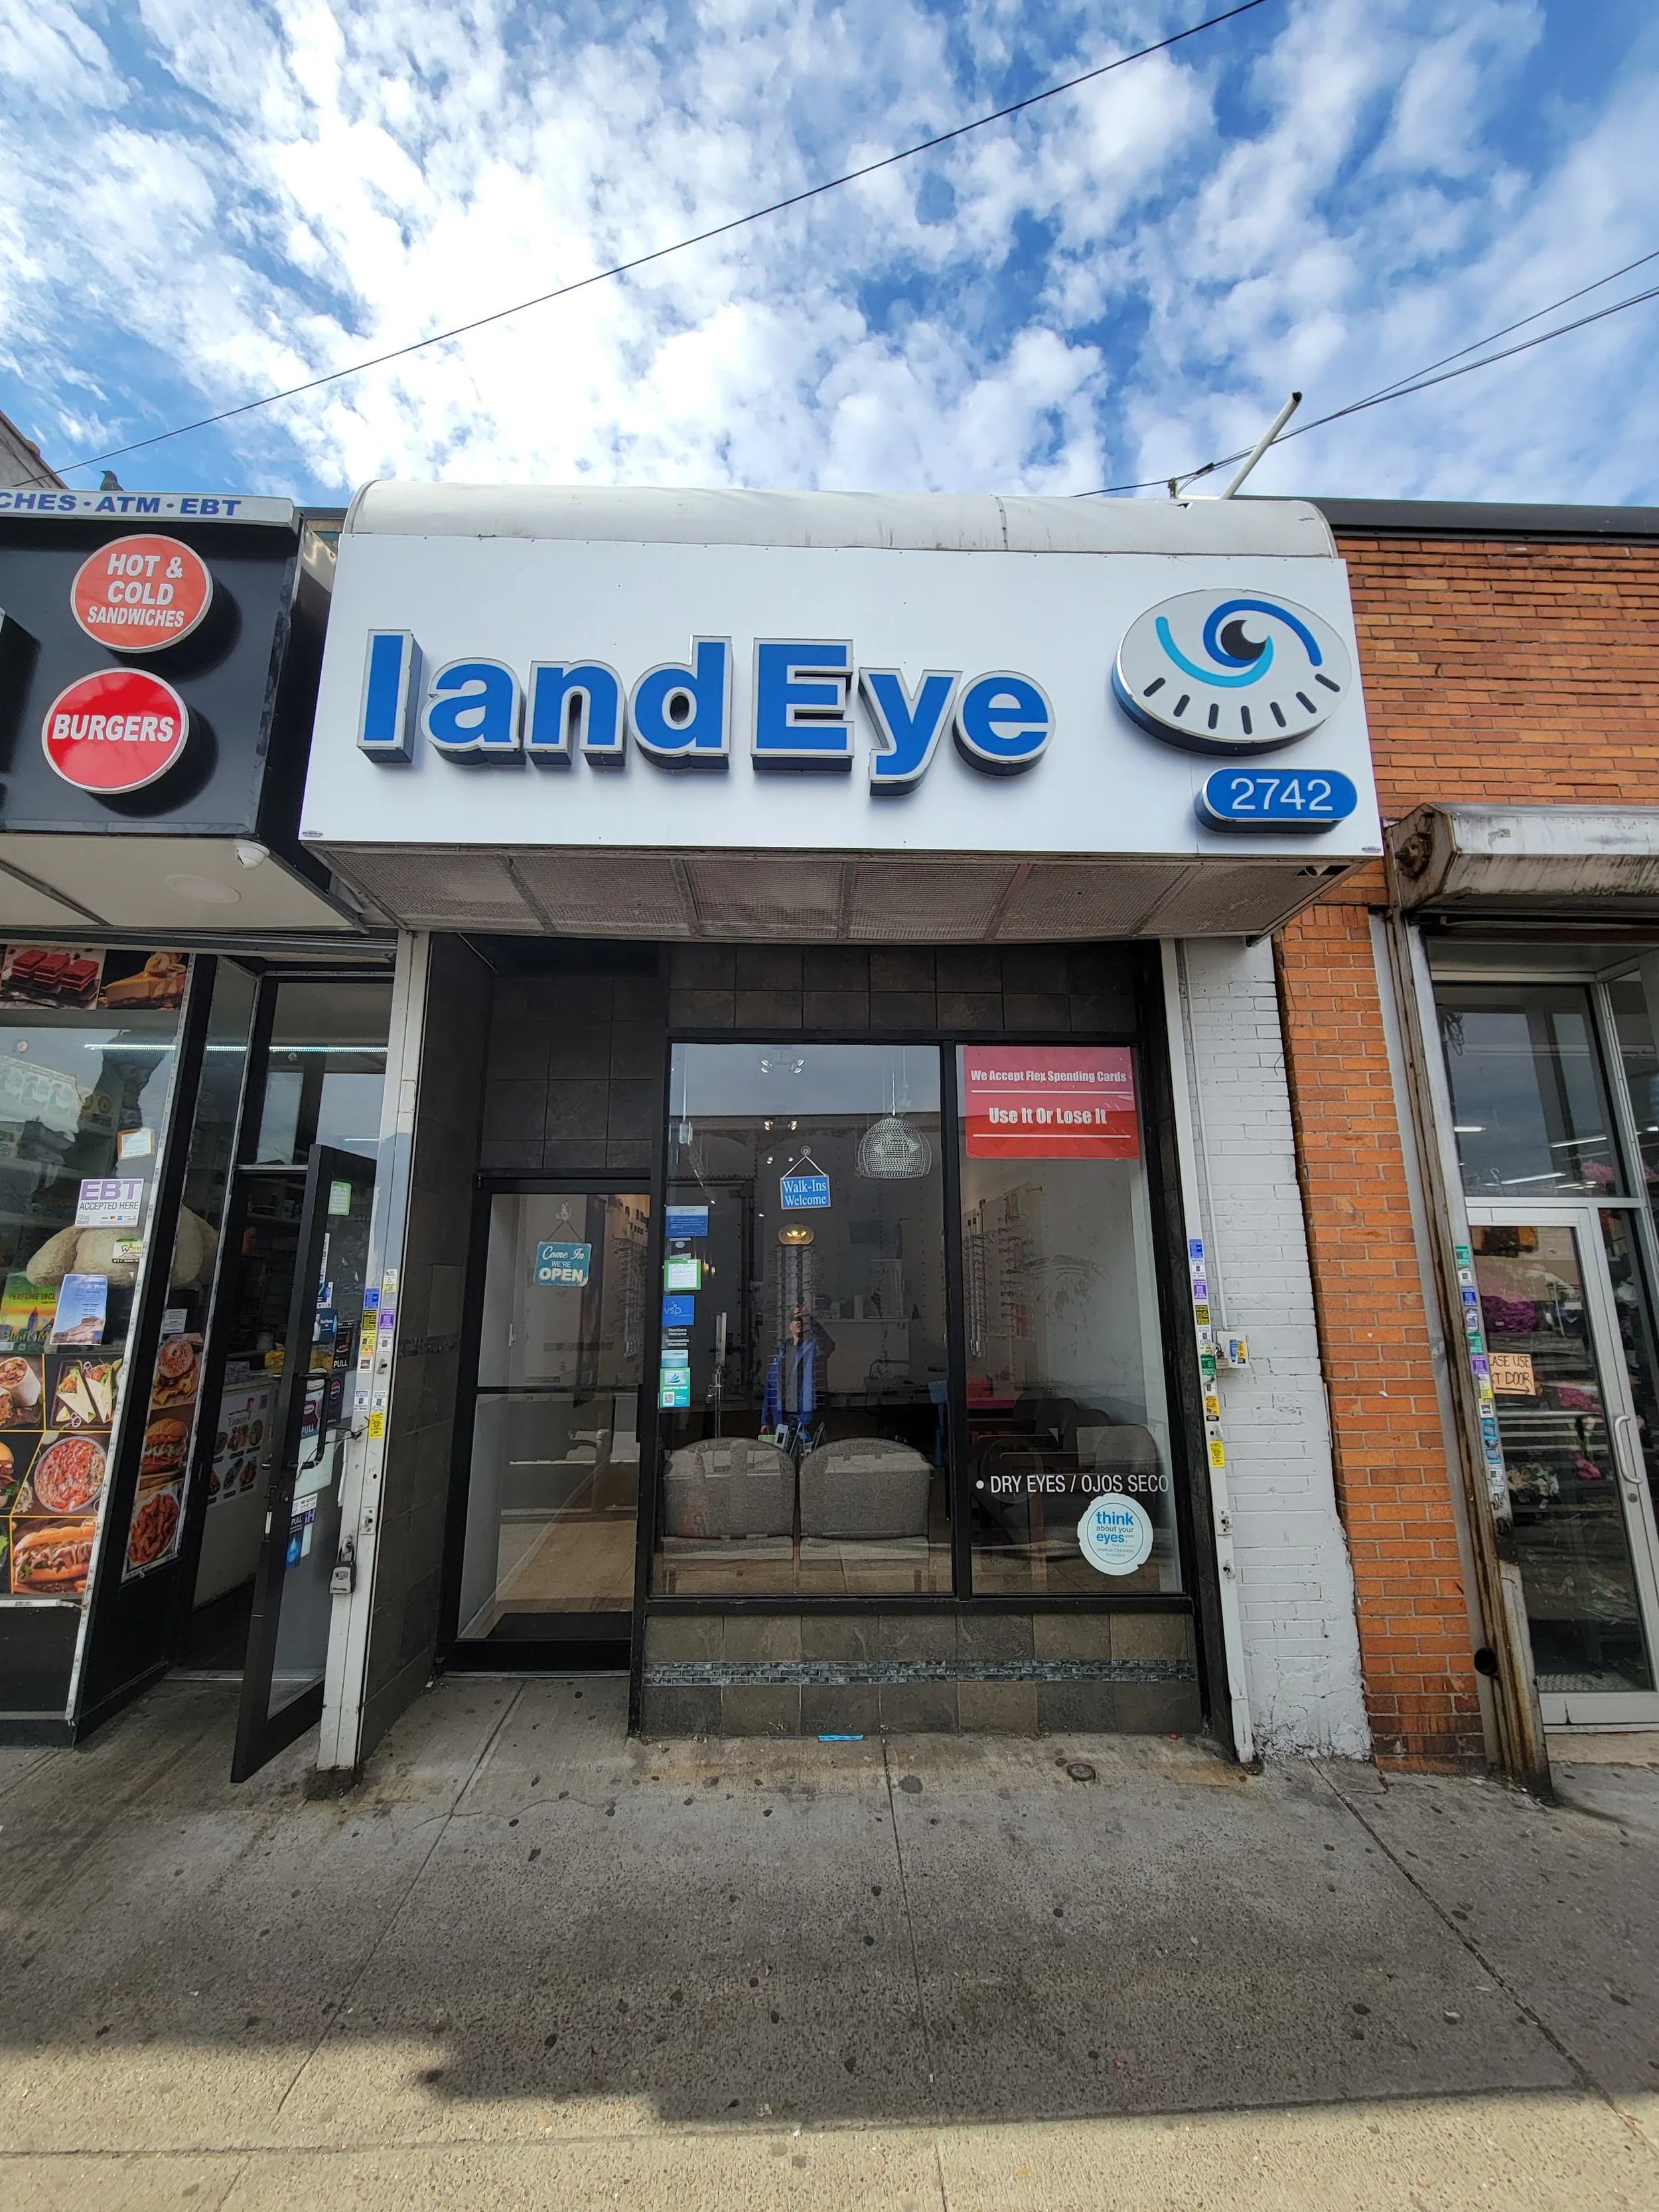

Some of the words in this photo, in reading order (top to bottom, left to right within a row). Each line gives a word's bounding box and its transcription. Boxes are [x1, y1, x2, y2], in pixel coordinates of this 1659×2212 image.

[95, 496, 161, 513] ATM
[180, 498, 242, 516] EBT
[107, 553, 161, 577] HOT
[166, 556, 183, 578] &
[108, 580, 174, 605] COLD
[87, 606, 184, 628] SANDWICHES
[52, 714, 174, 743] BURGERS
[1231, 778, 1333, 811] 2742
[971, 1070, 987, 1081] We
[989, 1070, 1024, 1082] Accept
[1026, 1070, 1046, 1082] Flex
[1048, 1070, 1095, 1082] Spending
[1097, 1071, 1126, 1082] Cards
[989, 1107, 1018, 1124] Use
[1022, 1108, 1033, 1124] It
[1036, 1107, 1052, 1124] Or
[1056, 1108, 1092, 1124] Lose
[1095, 1108, 1108, 1124] It
[81, 1181, 142, 1200] EBT
[783, 1179, 827, 1193] Walk-Ins
[785, 1195, 827, 1207] Welcome
[542, 1245, 568, 1260] Come
[571, 1248, 585, 1260] In
[539, 1268, 583, 1282] OPEN
[664, 1307, 682, 1317] vsp
[334, 1359, 348, 1368] PULL
[1513, 1355, 1530, 1368] USE
[1506, 1371, 1533, 1387] DOOR
[301, 1424, 314, 1434] PULL
[990, 1475, 1022, 1493] DRY
[1027, 1475, 1066, 1493] EYES
[1081, 1475, 1123, 1493] OJOS
[1128, 1475, 1169, 1493] SECO
[291, 1516, 302, 1526] PULL
[1096, 1511, 1133, 1525] think
[1096, 1533, 1124, 1544] eyes
